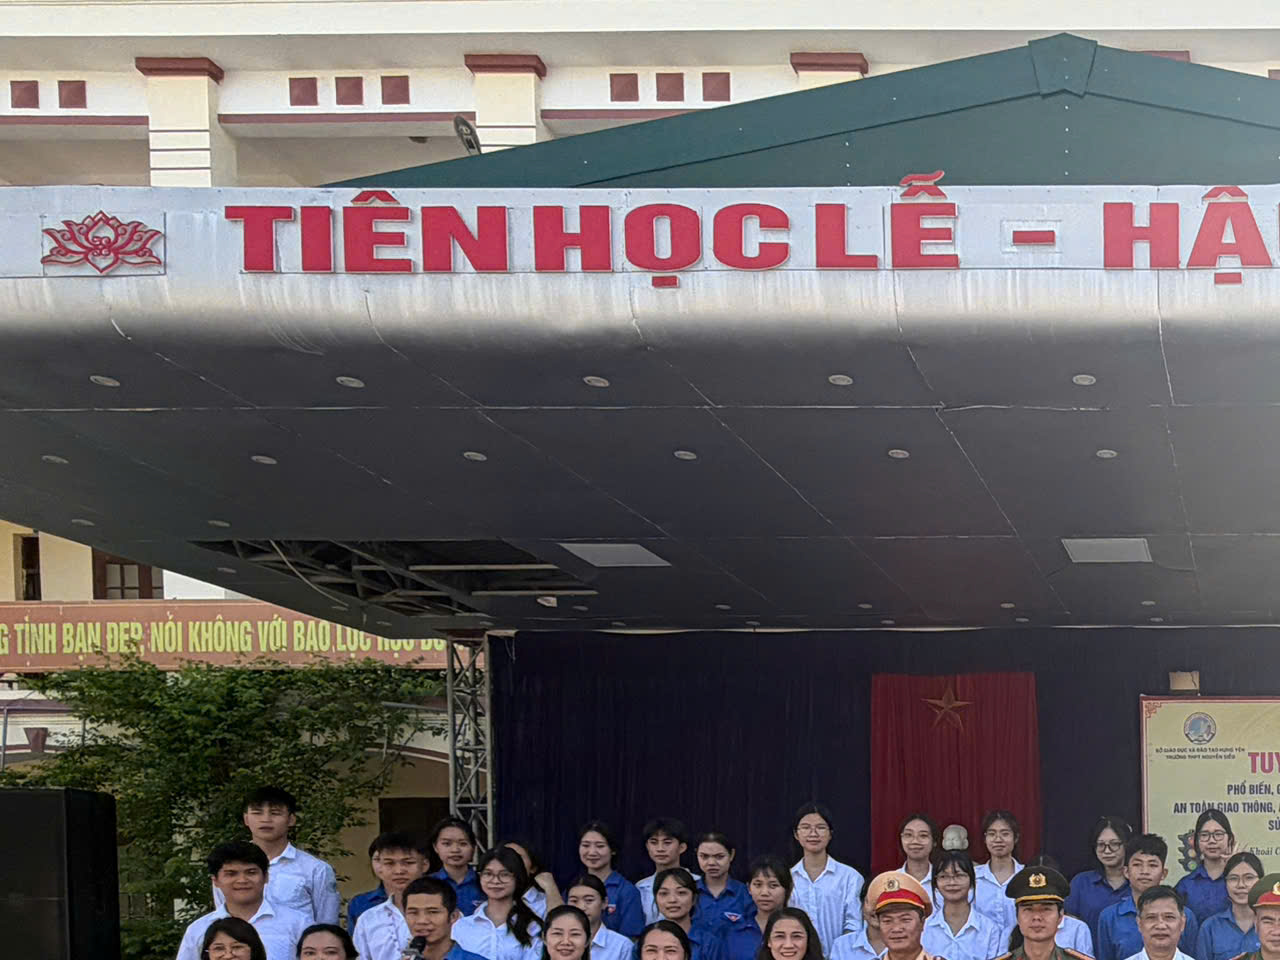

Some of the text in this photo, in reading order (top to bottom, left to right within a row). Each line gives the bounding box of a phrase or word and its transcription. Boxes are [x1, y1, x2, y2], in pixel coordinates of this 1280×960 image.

[225, 190, 509, 273] TIÊN
[533, 203, 790, 288] HỌC
[815, 170, 959, 270] LỄ
[1012, 230, 1055, 244] -
[188, 613, 252, 652] KHÔNG
[1227, 780, 1246, 795] PHỔ
[1249, 781, 1274, 796] BIẾN,
[1174, 803, 1187, 813] AN
[1190, 800, 1214, 813] TOÀN
[1242, 800, 1276, 814] THÔNG,
[1268, 816, 1280, 831] SỬ
